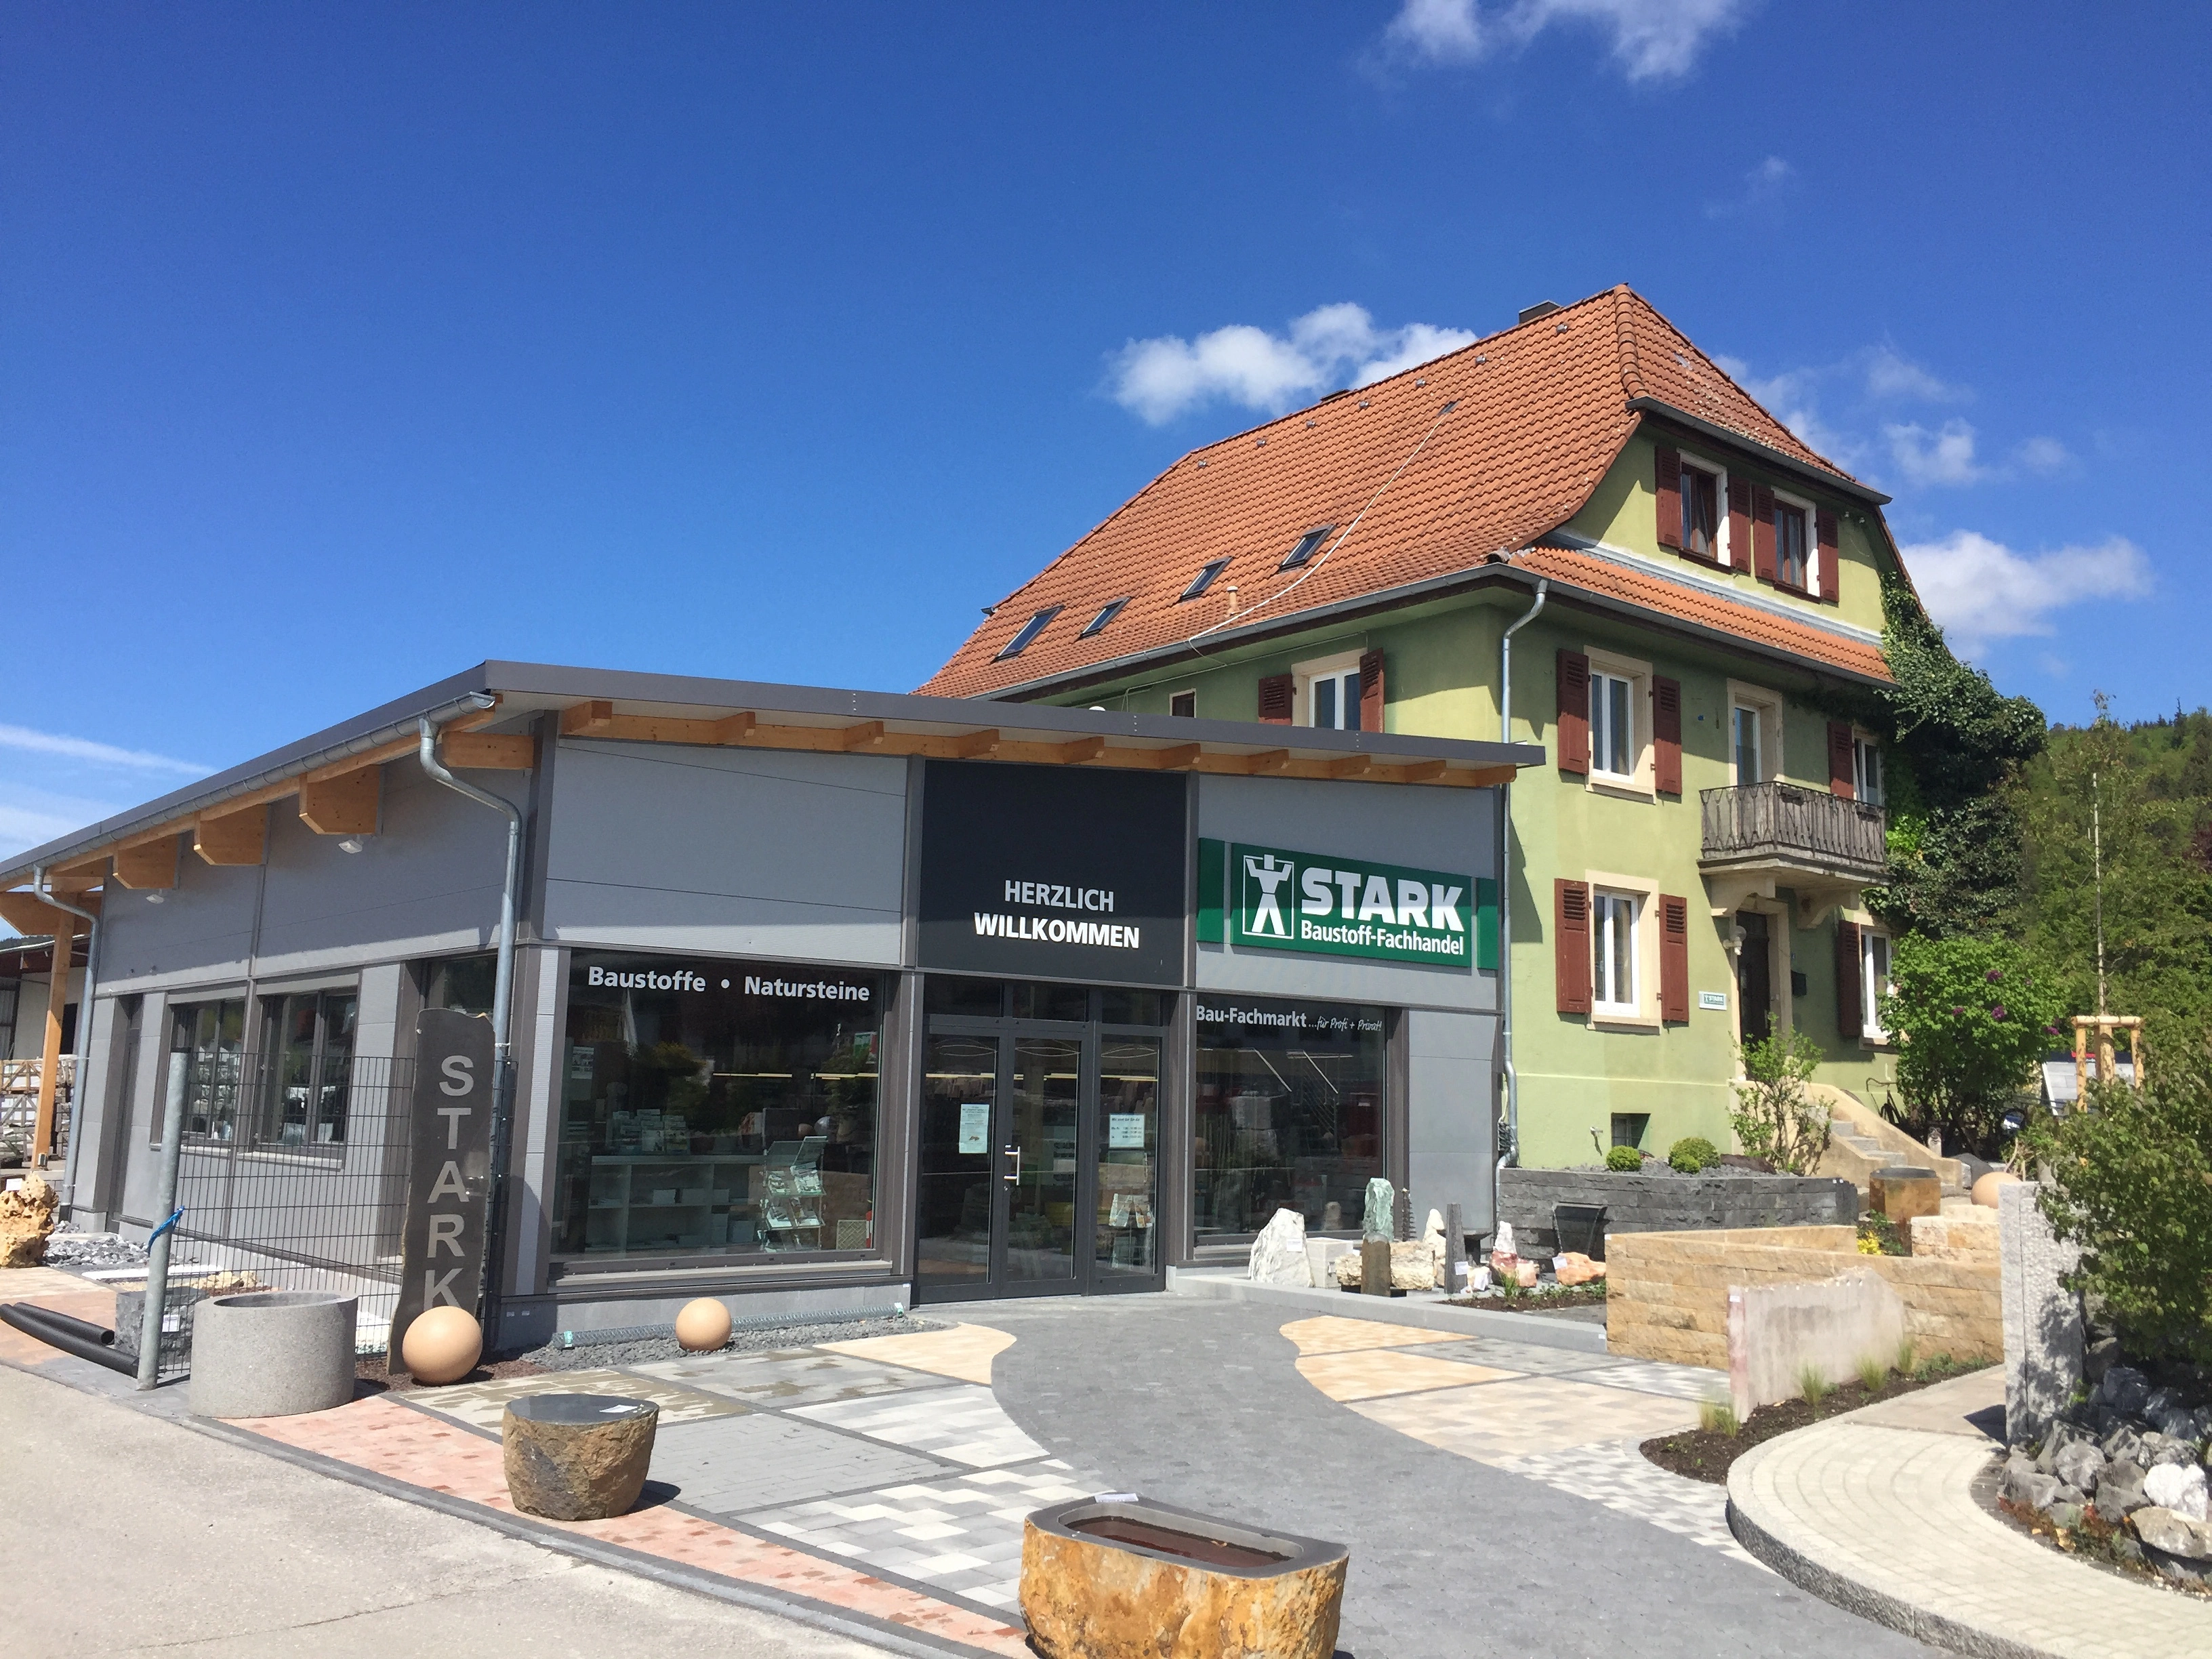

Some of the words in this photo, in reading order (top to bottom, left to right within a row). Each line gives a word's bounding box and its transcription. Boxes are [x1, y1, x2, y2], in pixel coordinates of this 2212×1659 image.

[1004, 880, 1114, 912] HERZLICH
[1300, 867, 1465, 933] STARK
[974, 912, 1140, 949] WILLKOMMEN
[1300, 919, 1464, 956] Baustoff-Fachhandel
[588, 966, 706, 992] Baustoffe
[744, 976, 870, 1001] Natursteine
[1196, 1005, 1307, 1027] Bau-Fachmarkt
[1330, 1017, 1349, 1031] Profi
[1357, 1019, 1382, 1031] Privat!
[423, 1055, 474, 1311] STARK
